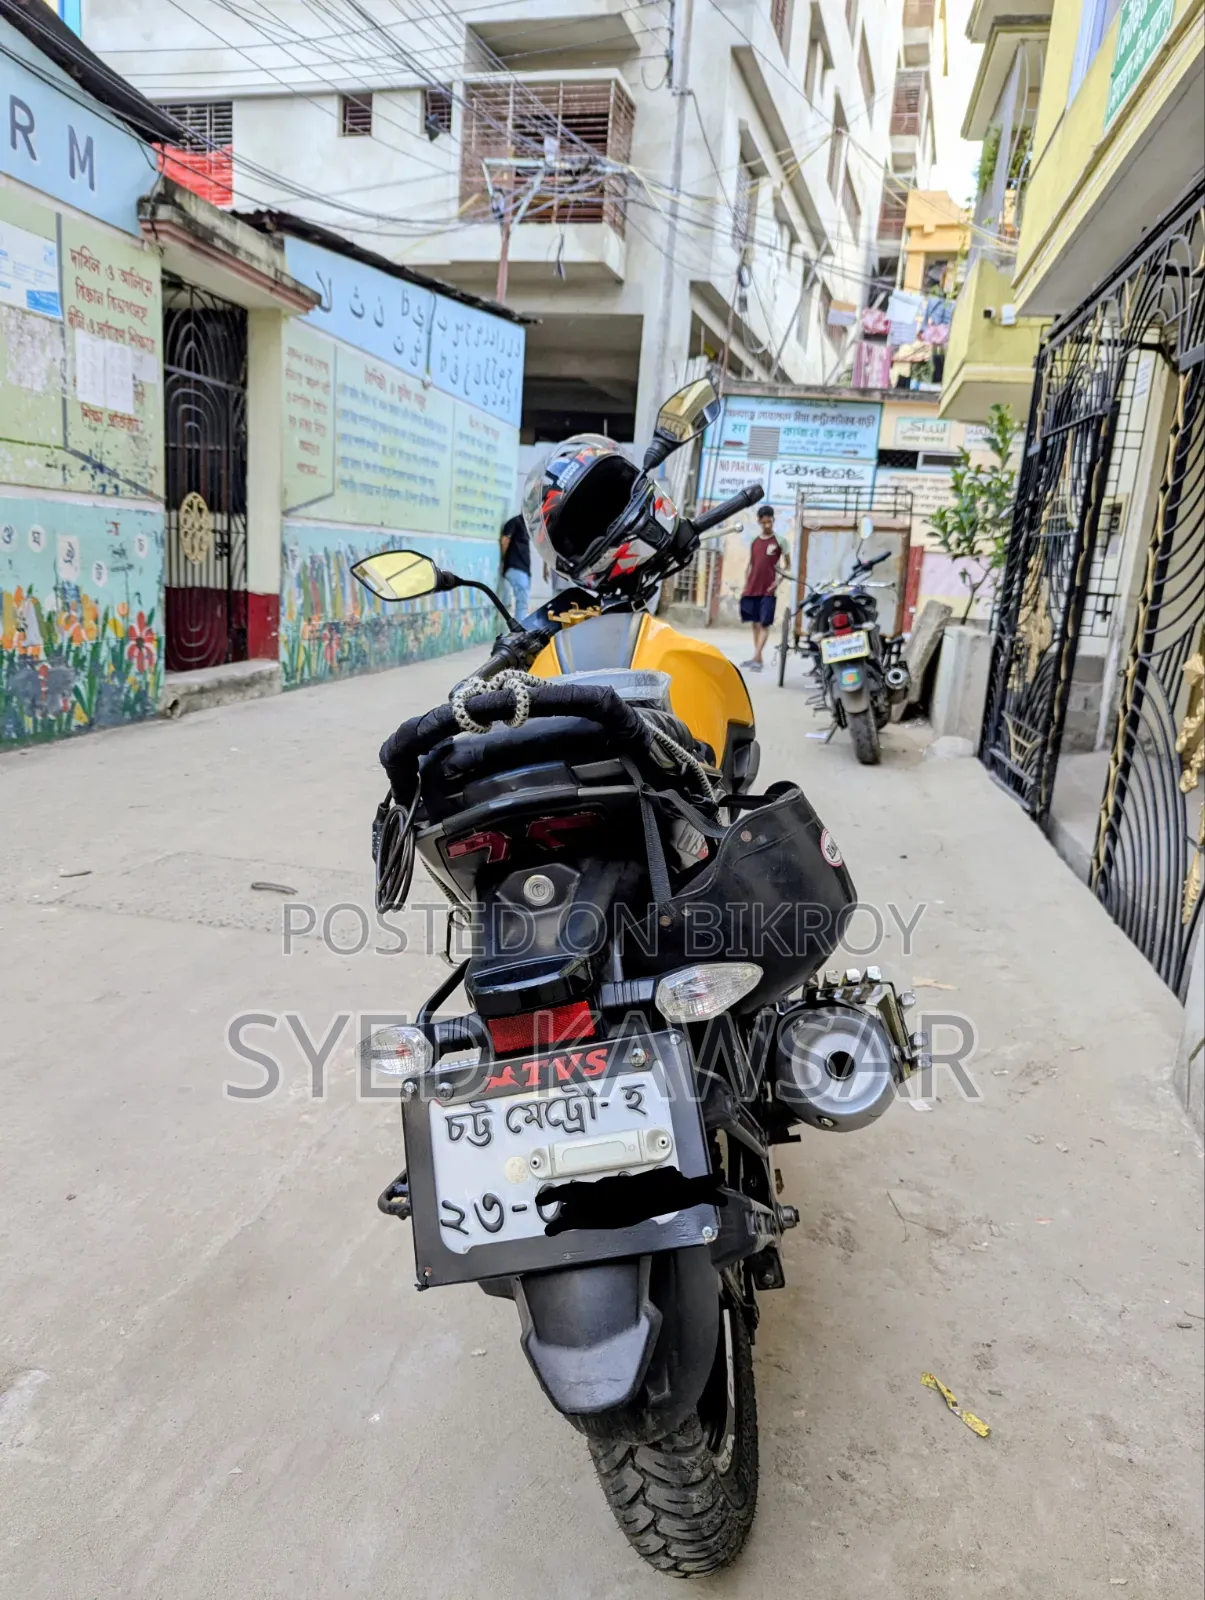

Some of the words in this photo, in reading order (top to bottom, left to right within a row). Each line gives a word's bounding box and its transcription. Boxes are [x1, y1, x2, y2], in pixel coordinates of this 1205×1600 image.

[719, 460, 730, 473] NO
[731, 460, 765, 474] PARKING
[520, 1048, 609, 1088] TVS
